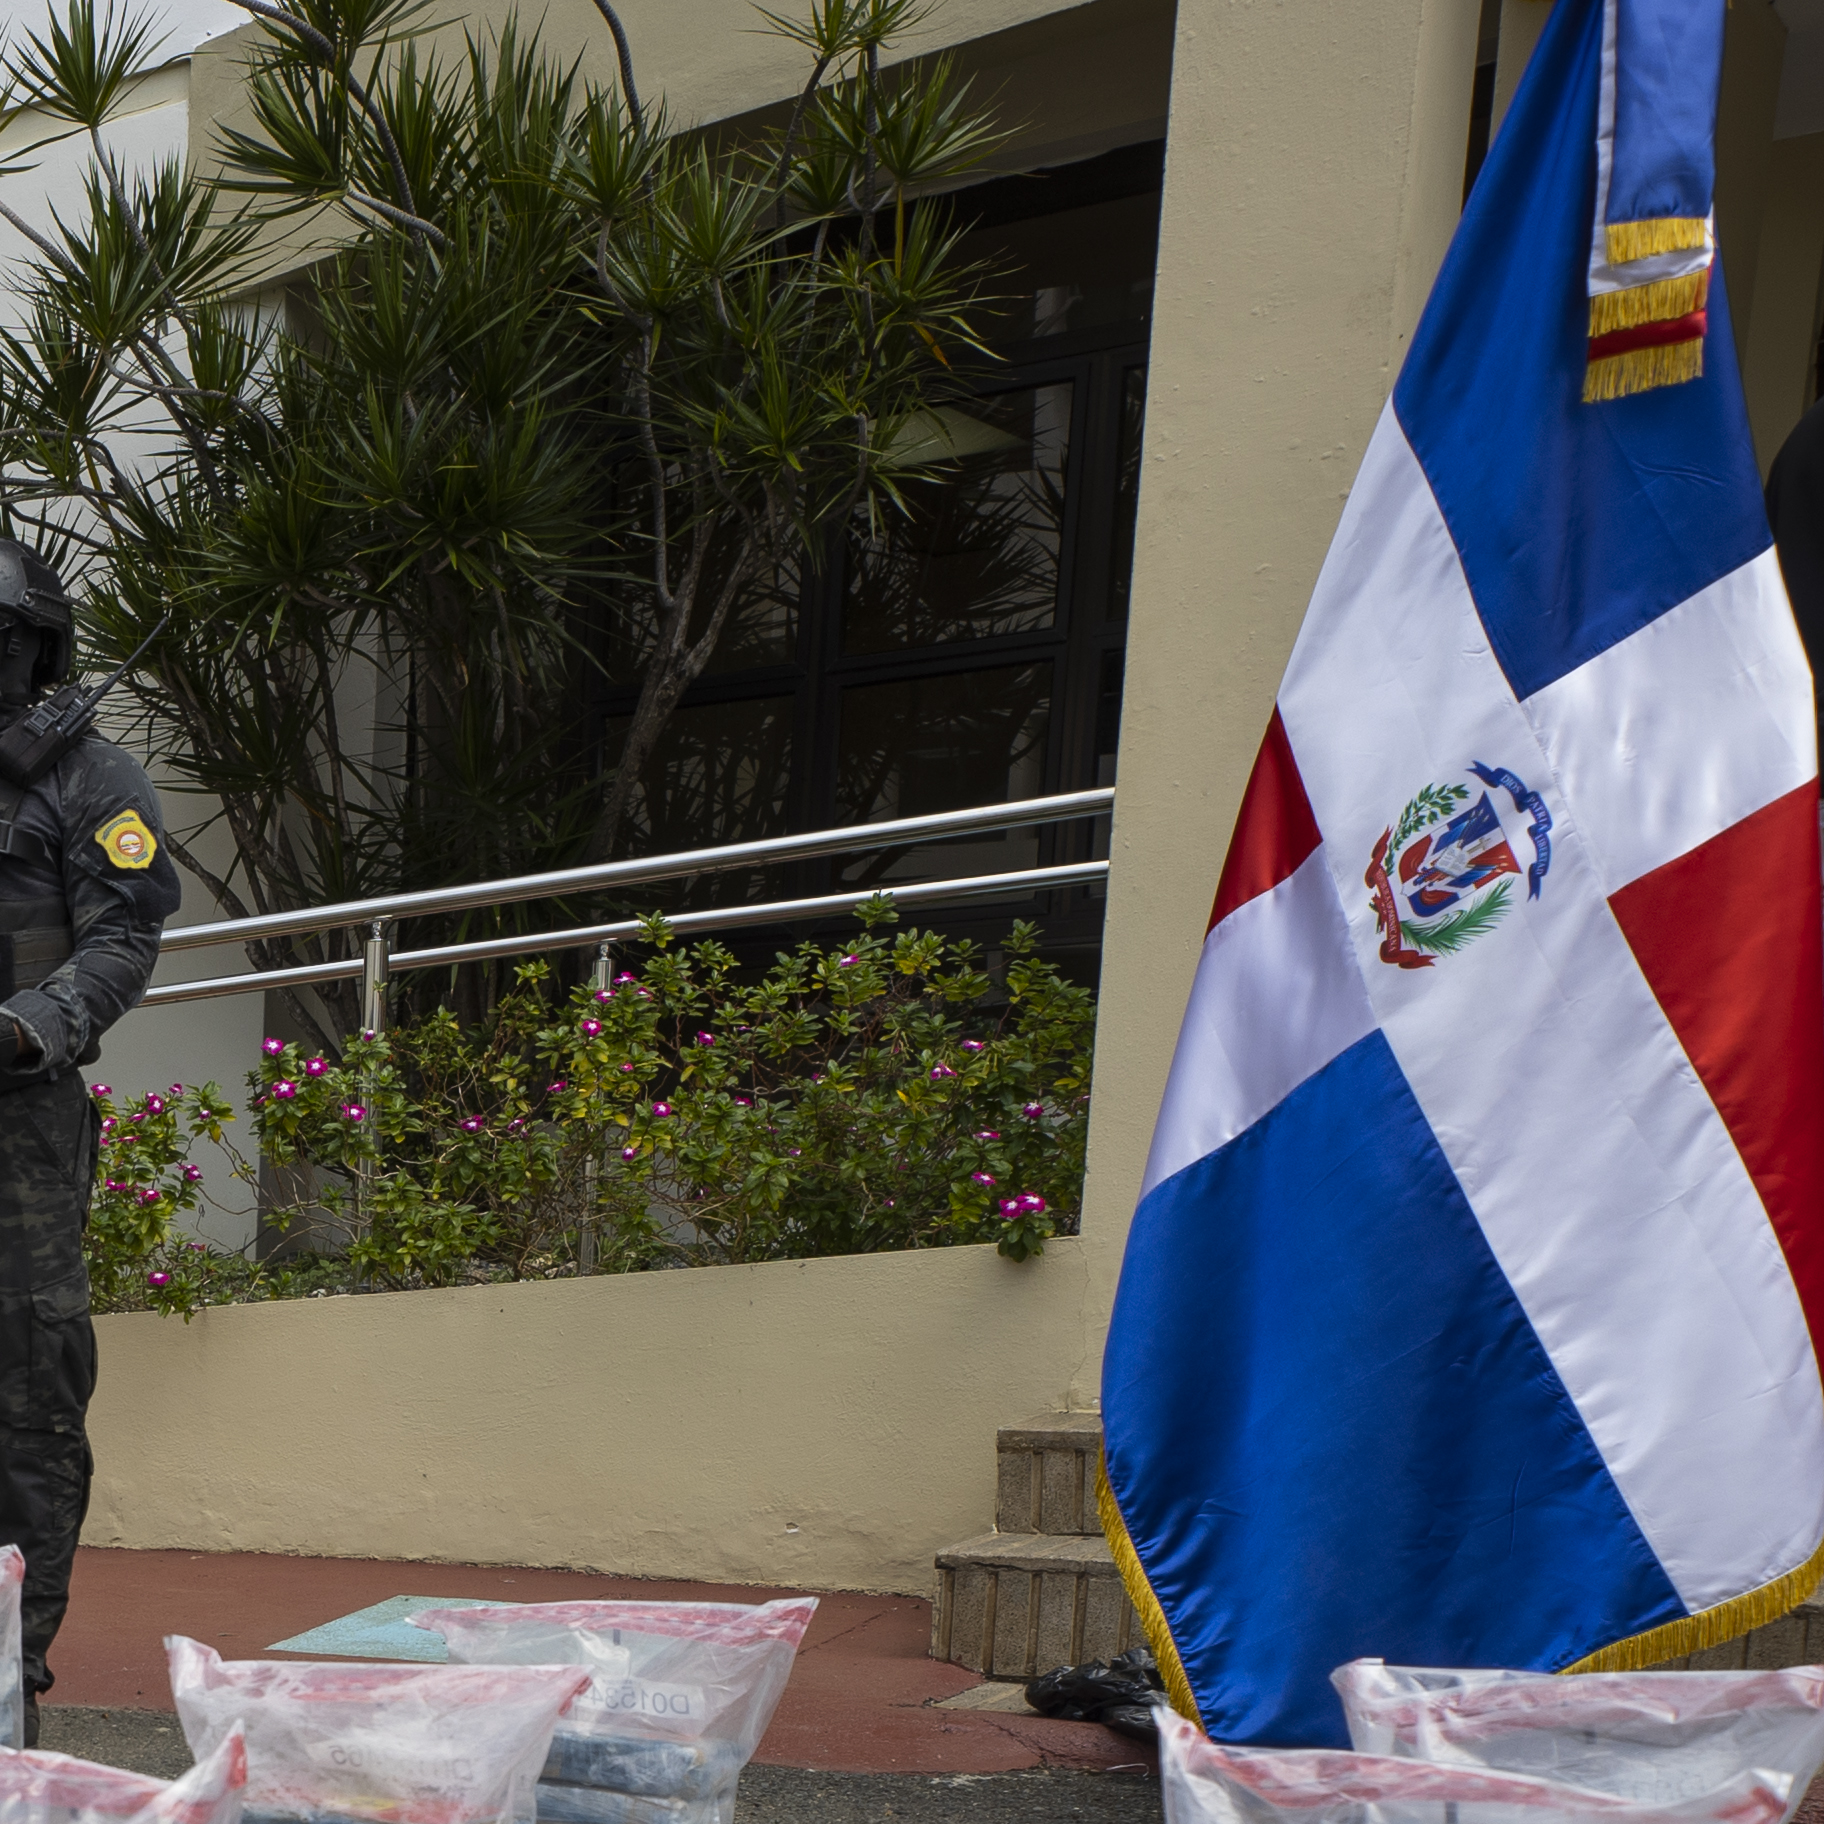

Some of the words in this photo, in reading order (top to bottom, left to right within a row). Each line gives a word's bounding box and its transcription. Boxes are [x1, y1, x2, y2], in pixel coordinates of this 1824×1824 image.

[1500, 774, 1523, 794] DIOS
[1527, 795, 1549, 833] PATRIA
[1534, 833, 1549, 875] LIBERTAD
